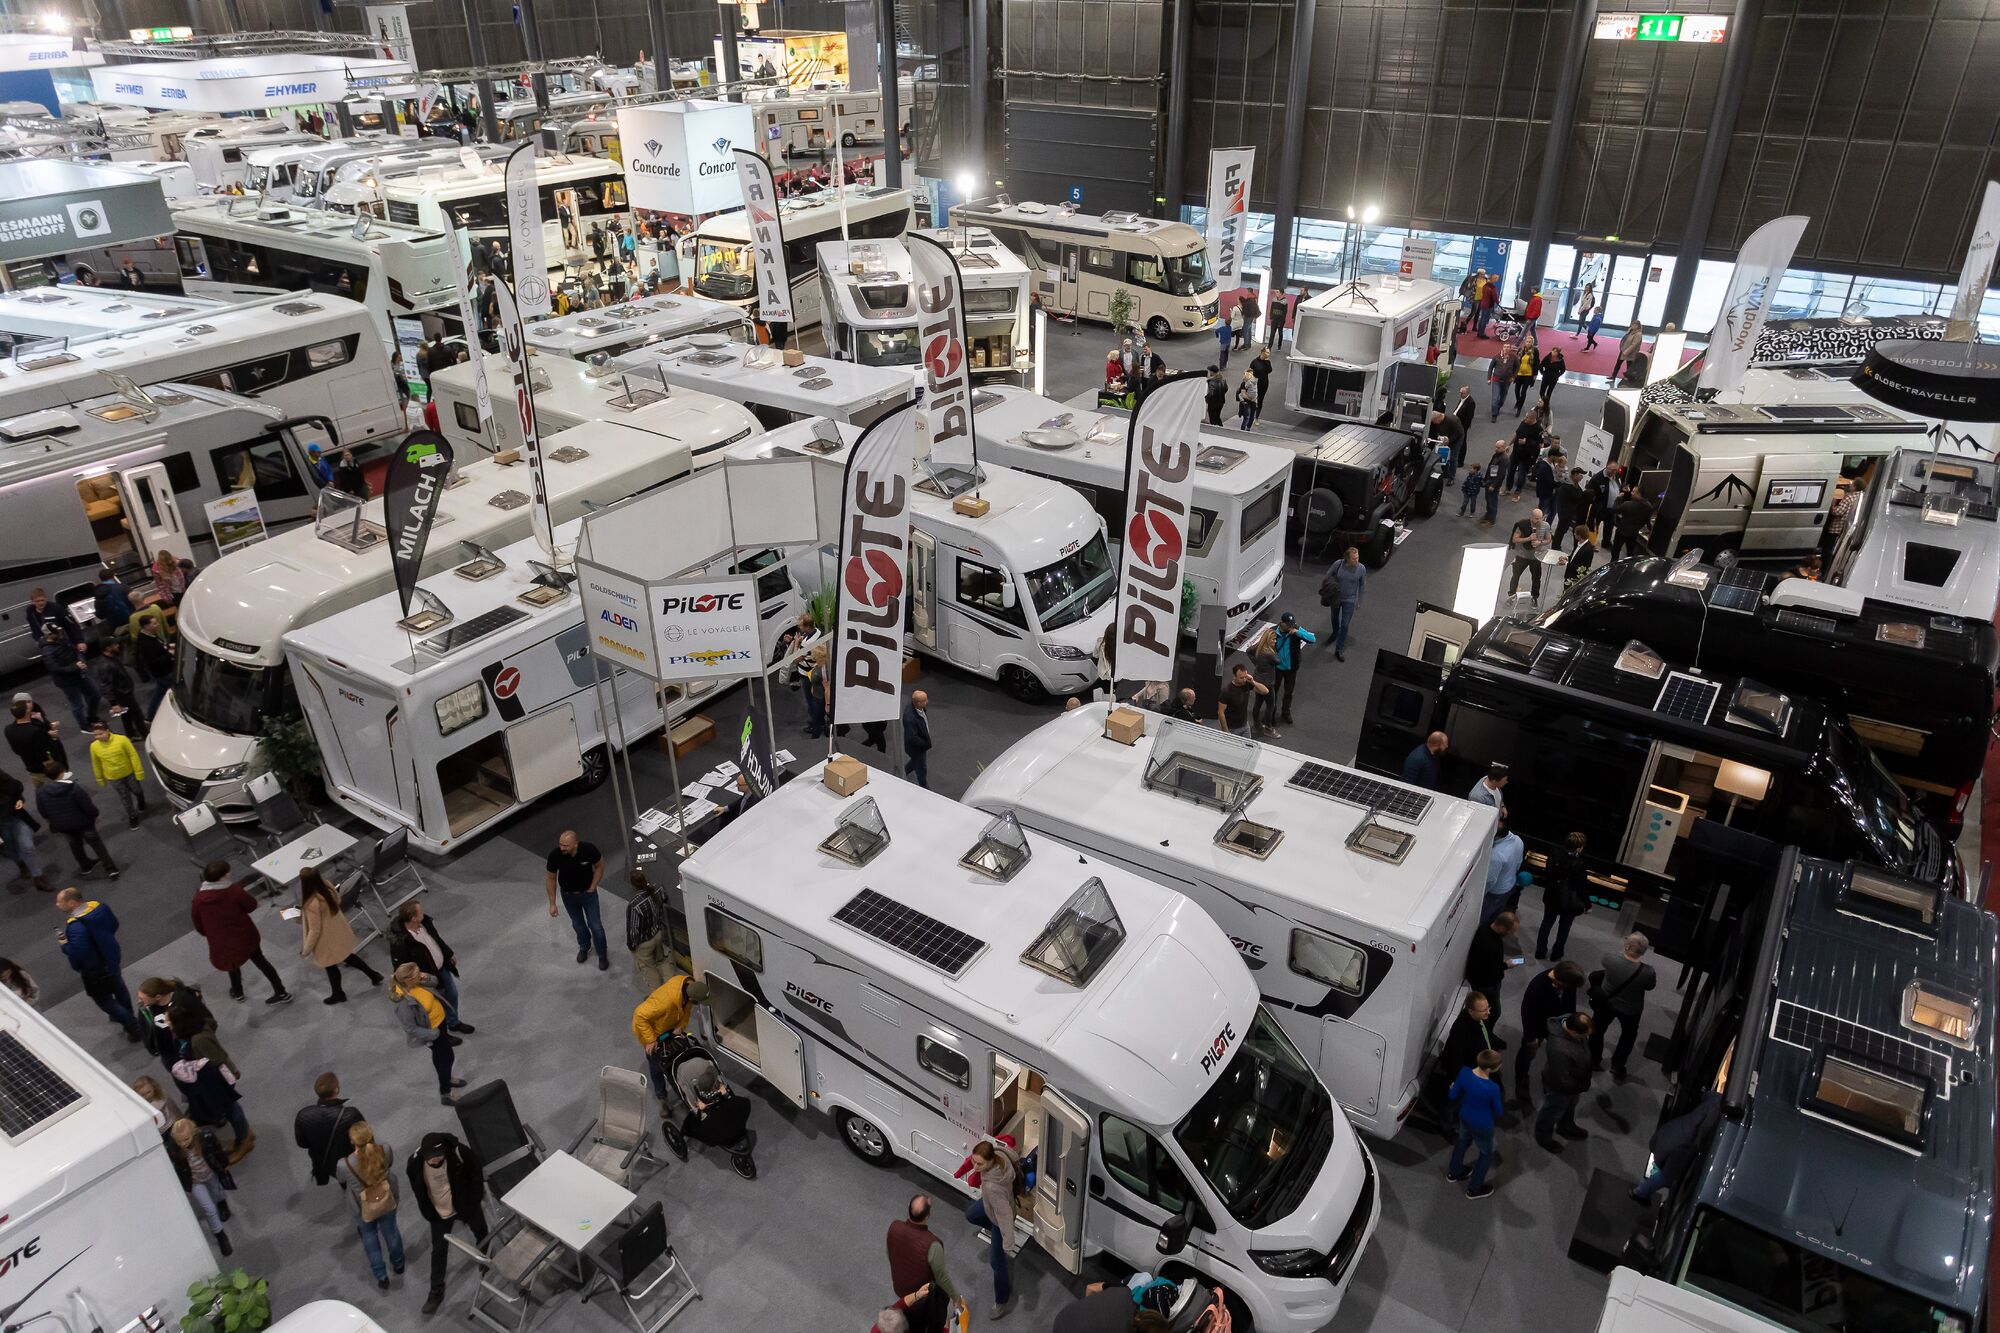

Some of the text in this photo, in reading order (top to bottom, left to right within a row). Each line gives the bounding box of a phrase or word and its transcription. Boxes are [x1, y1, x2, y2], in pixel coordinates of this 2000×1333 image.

[37, 50, 69, 60] ERIBA
[120, 83, 144, 95] HYMER
[167, 87, 187, 99] ERIBA
[274, 83, 317, 97] HYMER
[632, 158, 681, 178] Concorde
[699, 161, 736, 177] Concor
[1072, 187, 1081, 199] 5
[516, 167, 534, 270] LE VOYAGEUR
[0, 223, 66, 242] BISCHOFF
[1497, 242, 1507, 256] 8
[1874, 372, 1977, 404] GLOBE-TRAVELLER
[396, 473, 437, 560] MILACH
[687, 625, 751, 636] LE VOYAGEUR
[1226, 933, 1264, 957] OTE
[1369, 939, 1397, 954] G600
